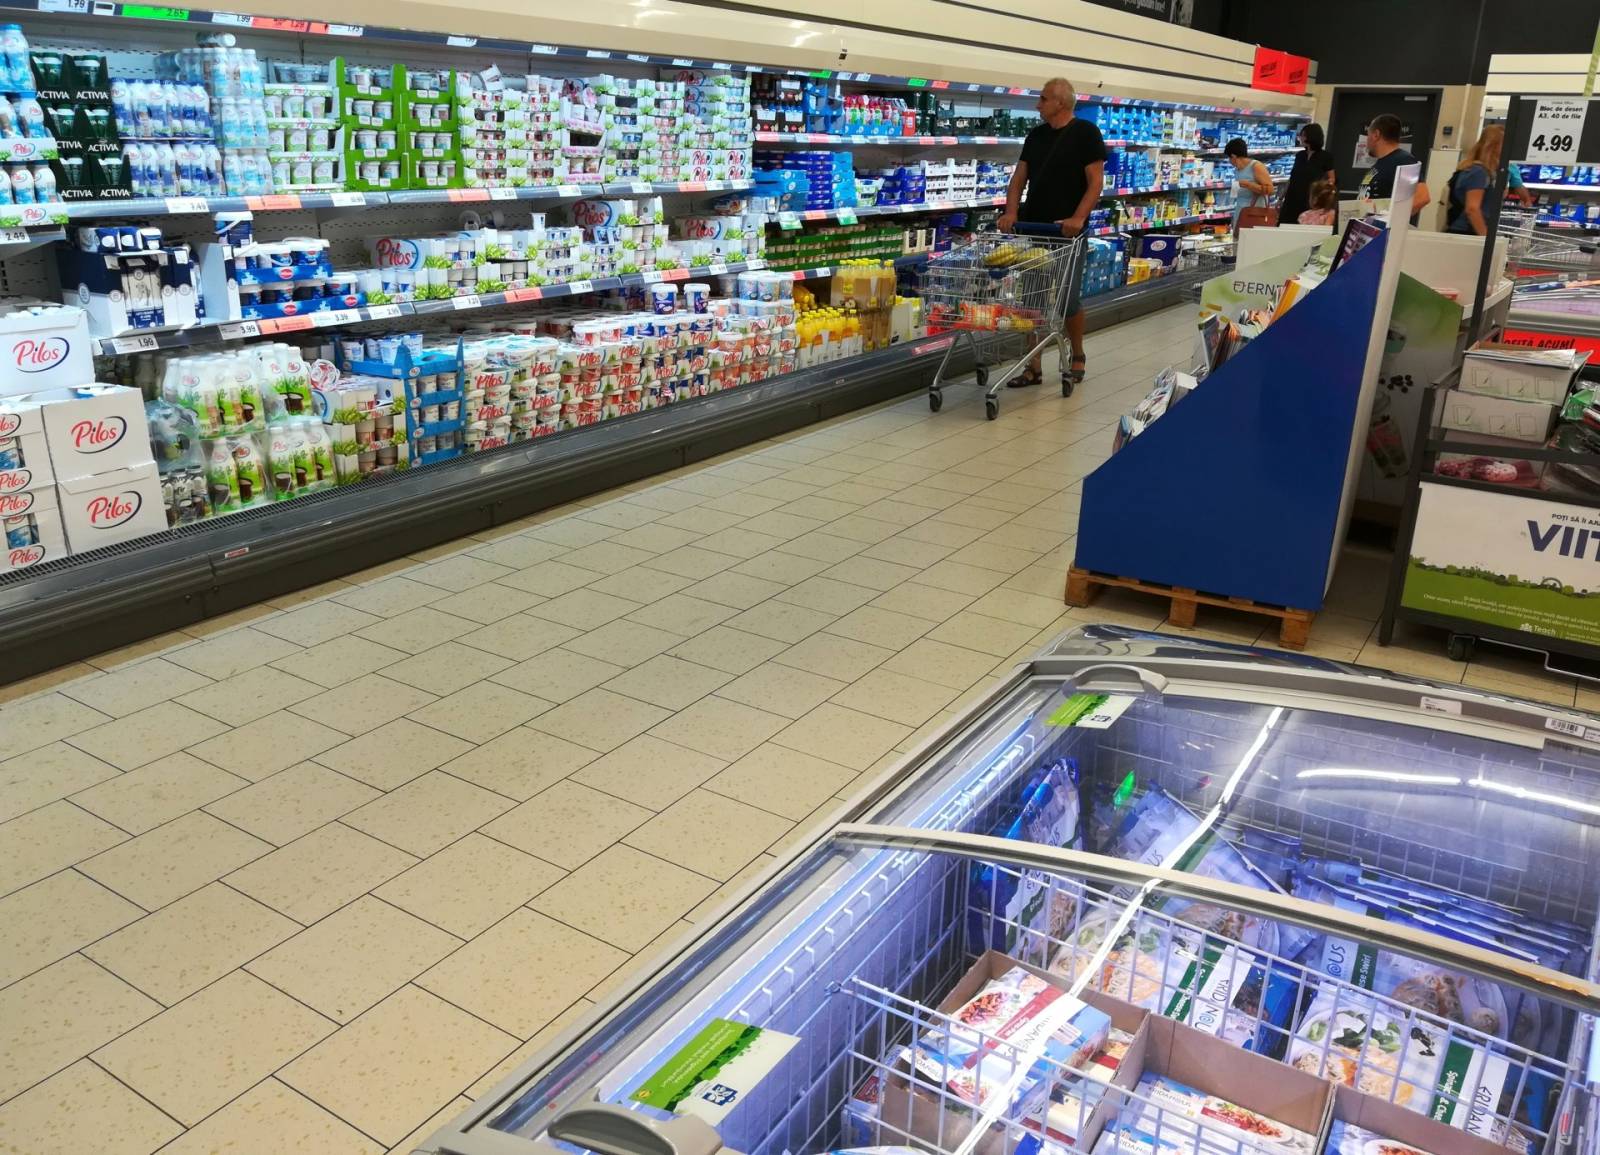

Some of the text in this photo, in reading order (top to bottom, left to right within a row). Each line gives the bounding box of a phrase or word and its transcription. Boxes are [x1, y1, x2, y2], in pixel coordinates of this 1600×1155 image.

[37, 91, 70, 99] ACTIVIA
[76, 91, 108, 99] ACTIVIA
[57, 141, 82, 149] CTIVIA
[88, 143, 119, 152] ACTIVIA
[1532, 134, 1573, 152] 4.99
[61, 190, 93, 198] ACTIVIA
[100, 189, 131, 197] ACTIVIA
[5, 232, 26, 241] 2.49
[376, 239, 412, 266] Pilos
[138, 338, 155, 347] 1.99
[12, 336, 60, 366] Pilos
[0, 415, 15, 429] los
[71, 420, 118, 448] Pilos
[0, 473, 26, 488] Pilos
[0, 495, 29, 512] Pilos
[87, 496, 133, 524] Pilos
[9, 549, 40, 565] Pilos
